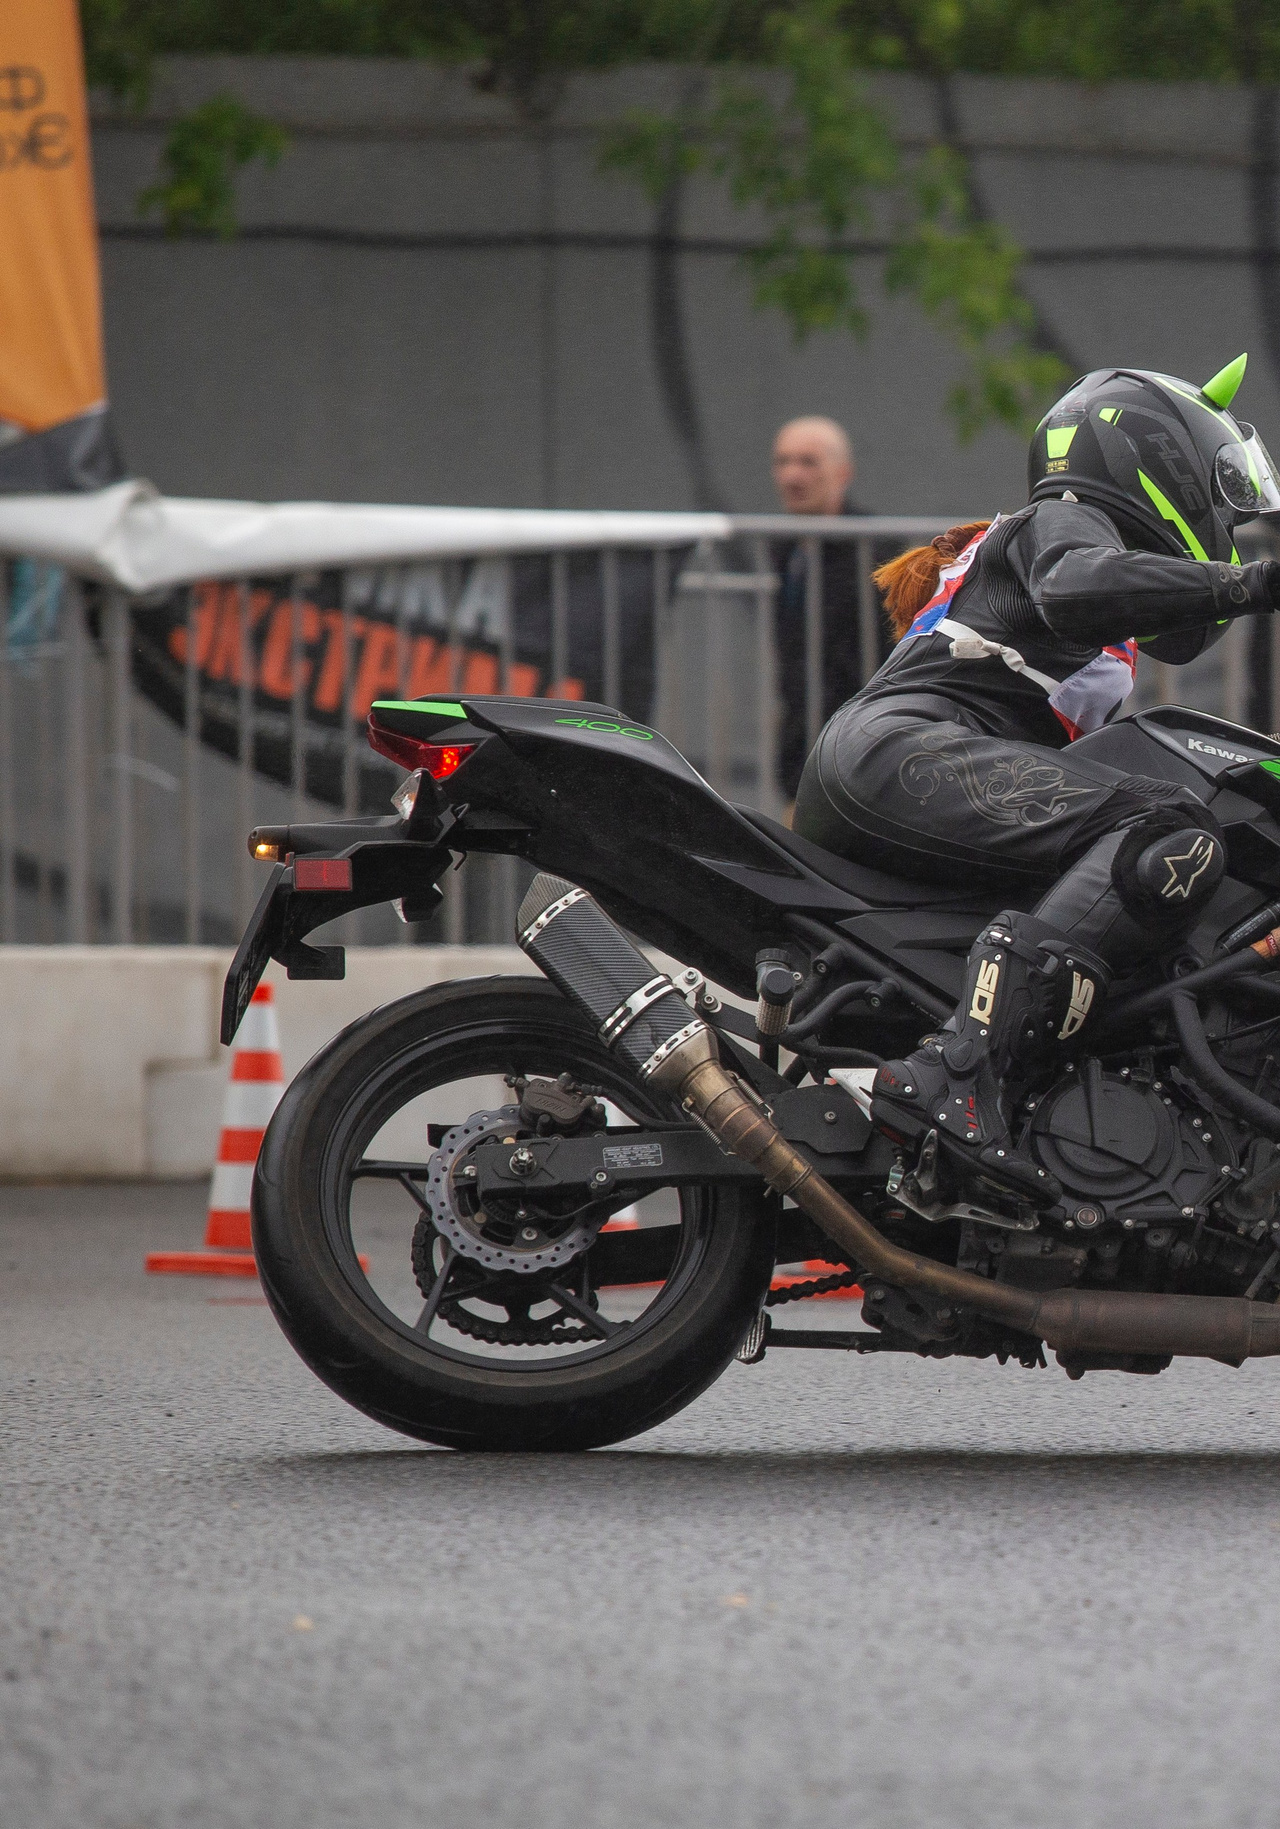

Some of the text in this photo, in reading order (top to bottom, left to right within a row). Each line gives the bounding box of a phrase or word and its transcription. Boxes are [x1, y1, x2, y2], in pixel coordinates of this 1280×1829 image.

[1145, 431, 1207, 512] HJC
[554, 718, 654, 741] 400
[1187, 737, 1257, 764] Kawa
